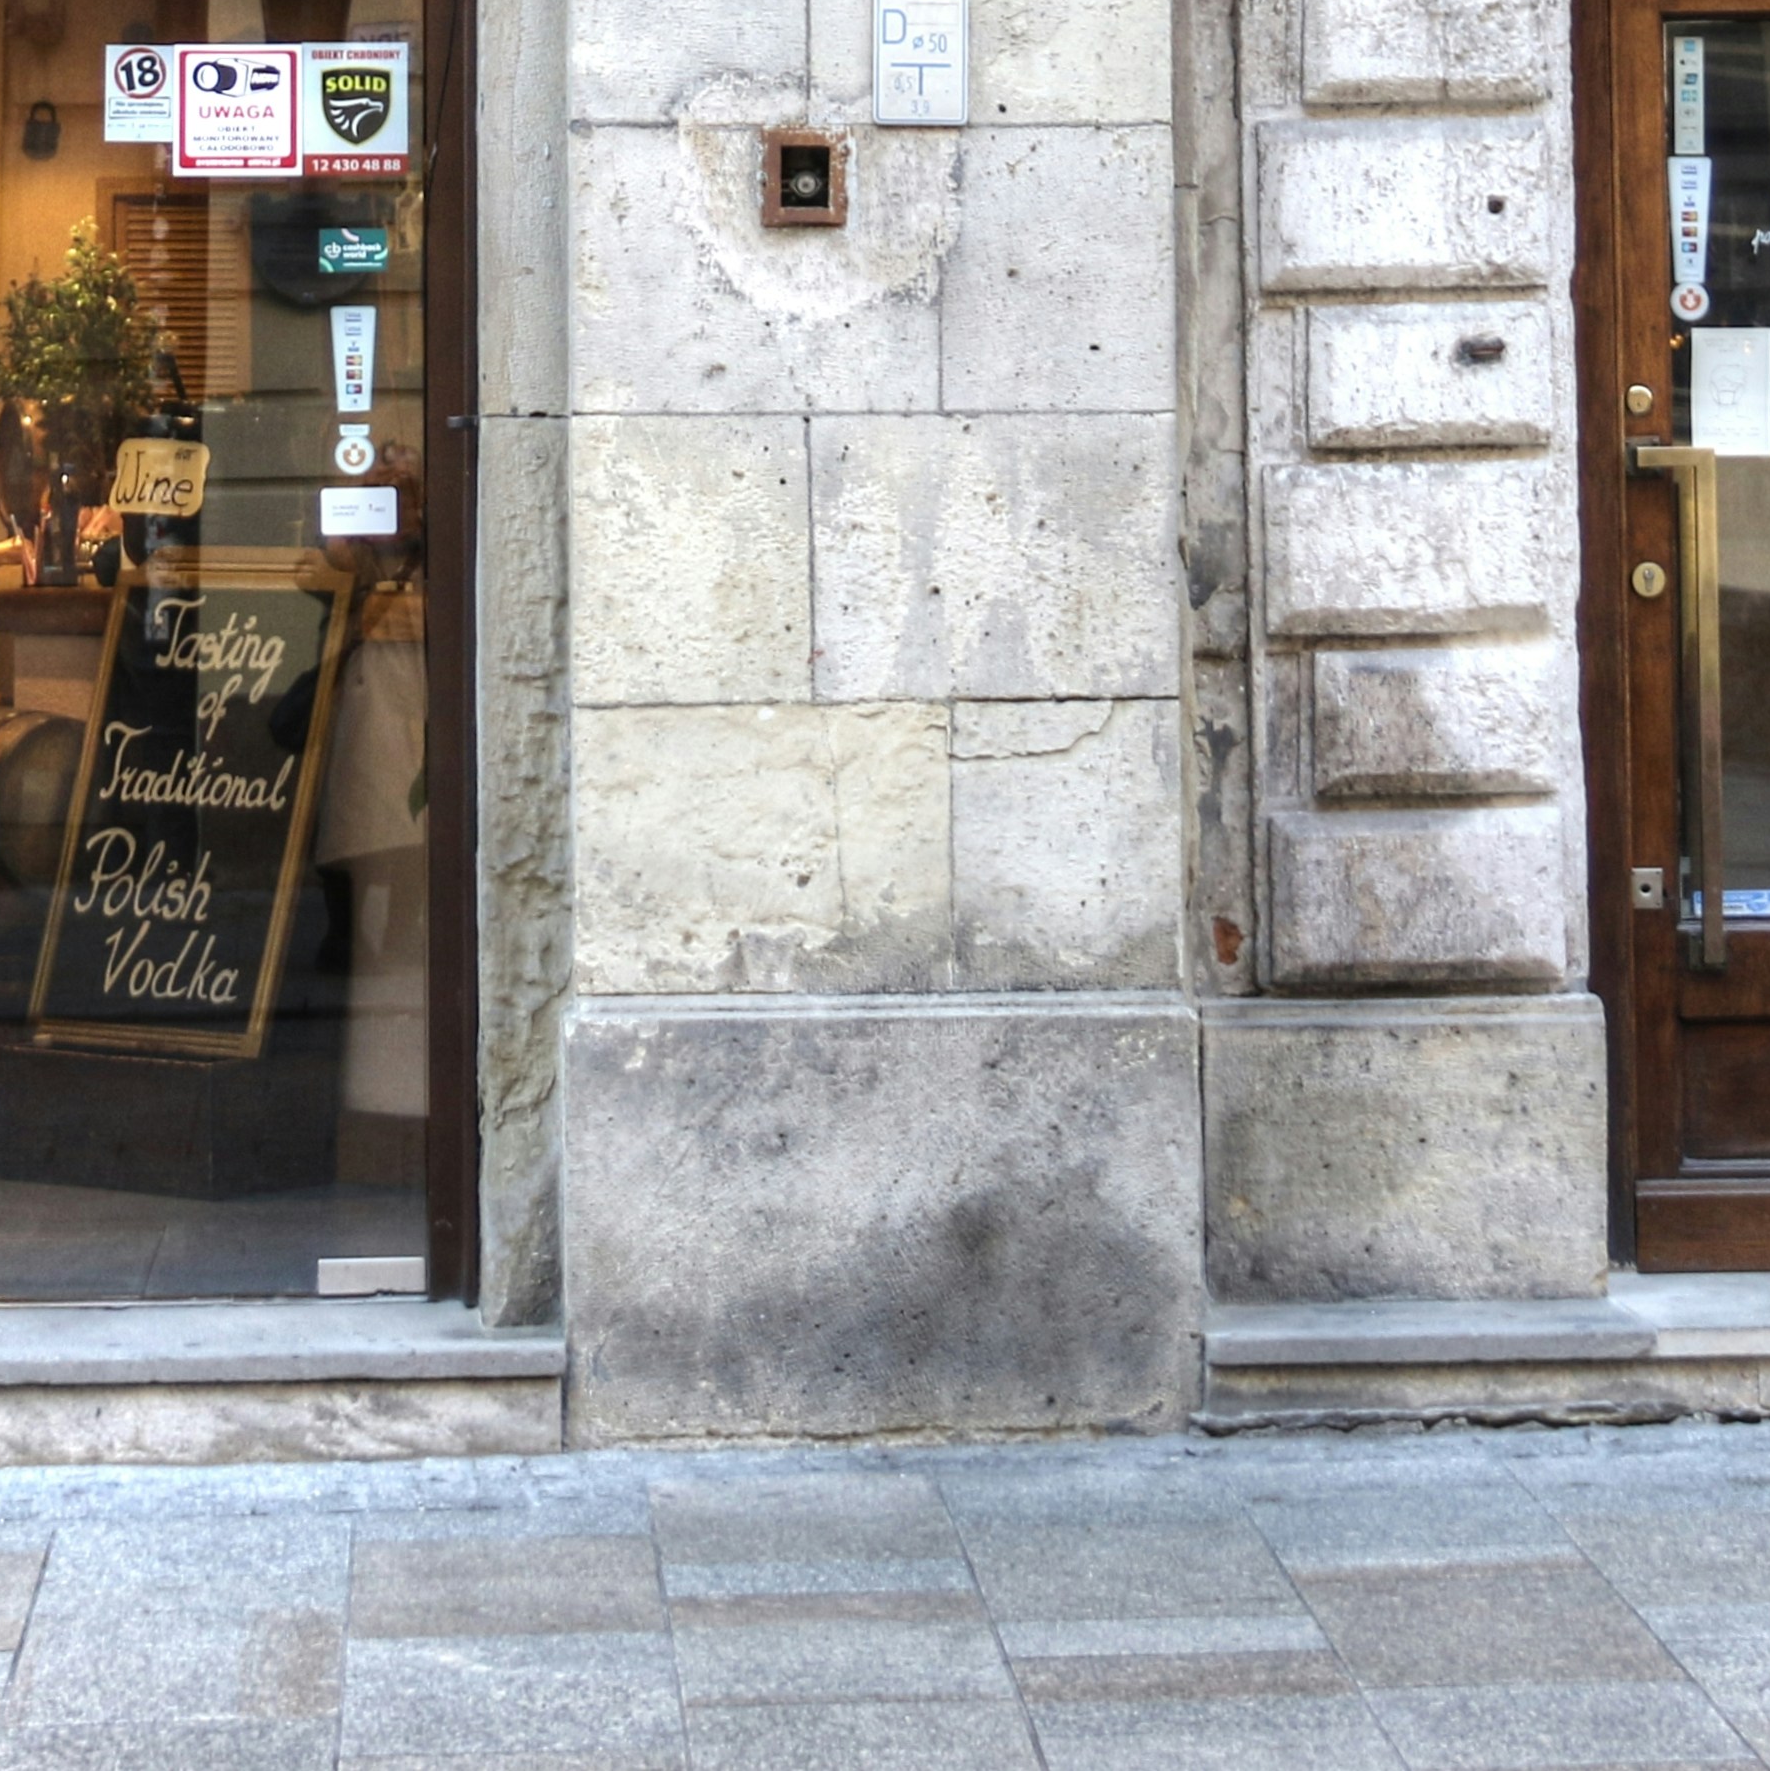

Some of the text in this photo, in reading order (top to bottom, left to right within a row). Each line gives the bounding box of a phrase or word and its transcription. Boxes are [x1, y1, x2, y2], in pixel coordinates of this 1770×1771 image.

[882, 9, 908, 45] D
[928, 33, 948, 54] 50
[120, 55, 160, 91] 18
[311, 50, 343, 60] OBIEKT
[325, 76, 387, 92] SOLID
[198, 105, 275, 119] UWAGA
[312, 159, 401, 171] 12 430 48 88
[115, 450, 194, 507] Wine
[154, 595, 286, 704] Tasting
[197, 674, 243, 740] of
[100, 723, 296, 812] Traditional
[74, 827, 212, 921] Polish
[103, 920, 239, 1004] Vodka
